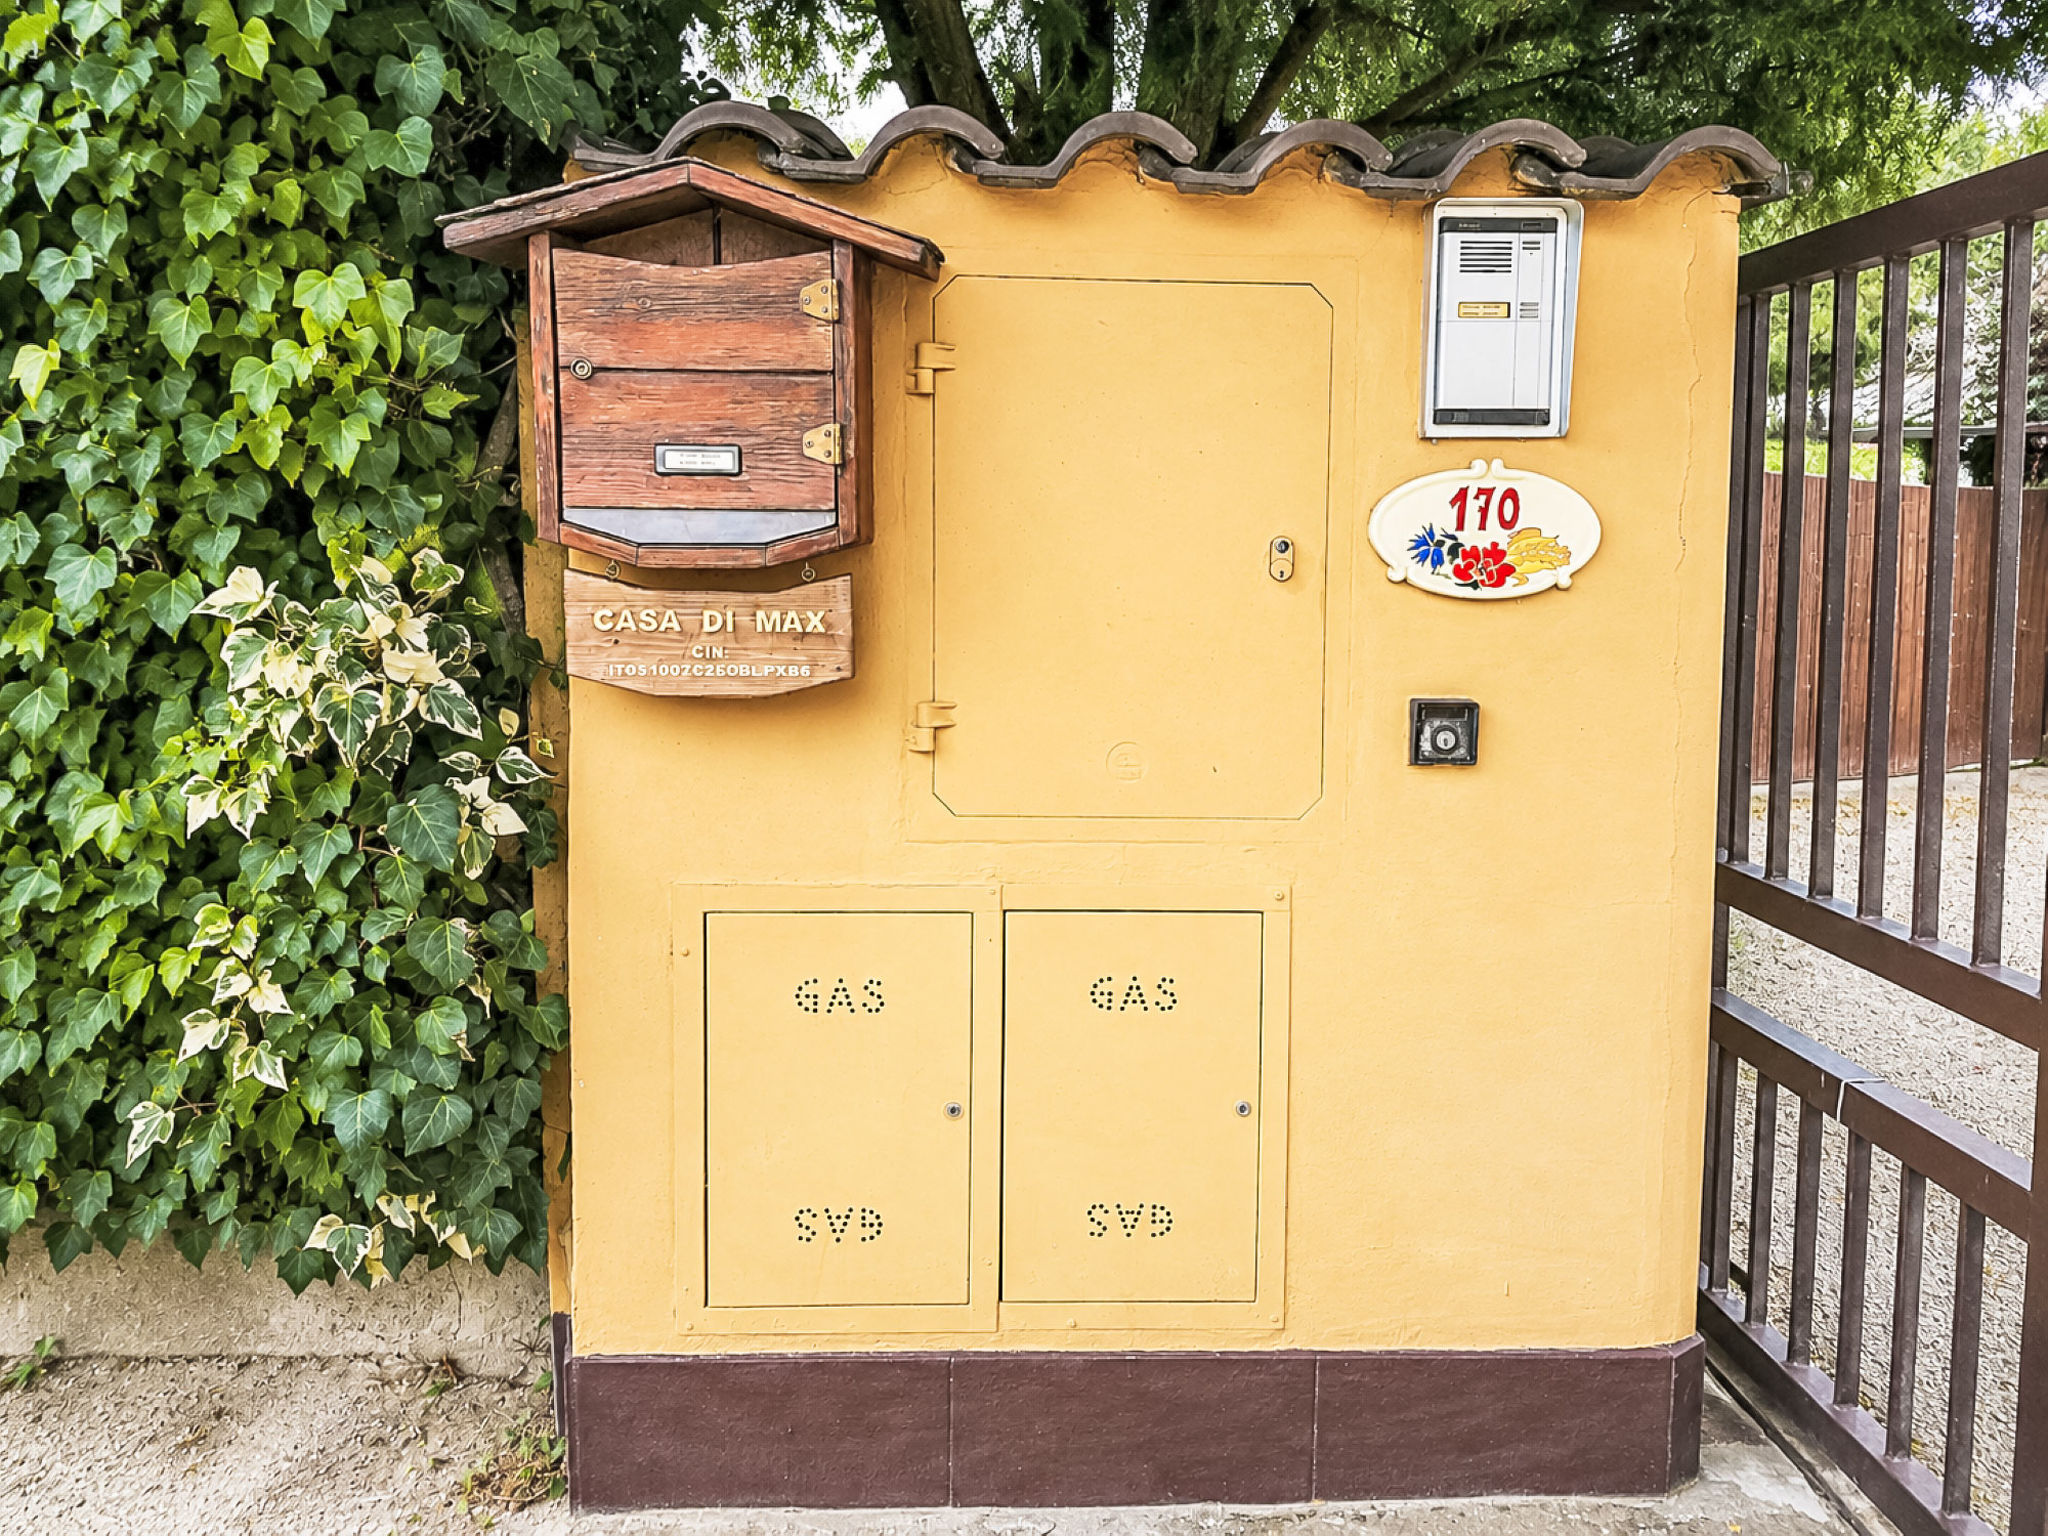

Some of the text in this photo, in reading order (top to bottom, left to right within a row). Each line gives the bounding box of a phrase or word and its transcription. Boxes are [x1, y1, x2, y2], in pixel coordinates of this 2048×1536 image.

[1449, 486, 1520, 531] 170
[593, 608, 826, 633] CASA DI MAX
[691, 645, 729, 659] CIN:
[795, 978, 885, 1014] GAS
[1089, 976, 1178, 1012] GAS
